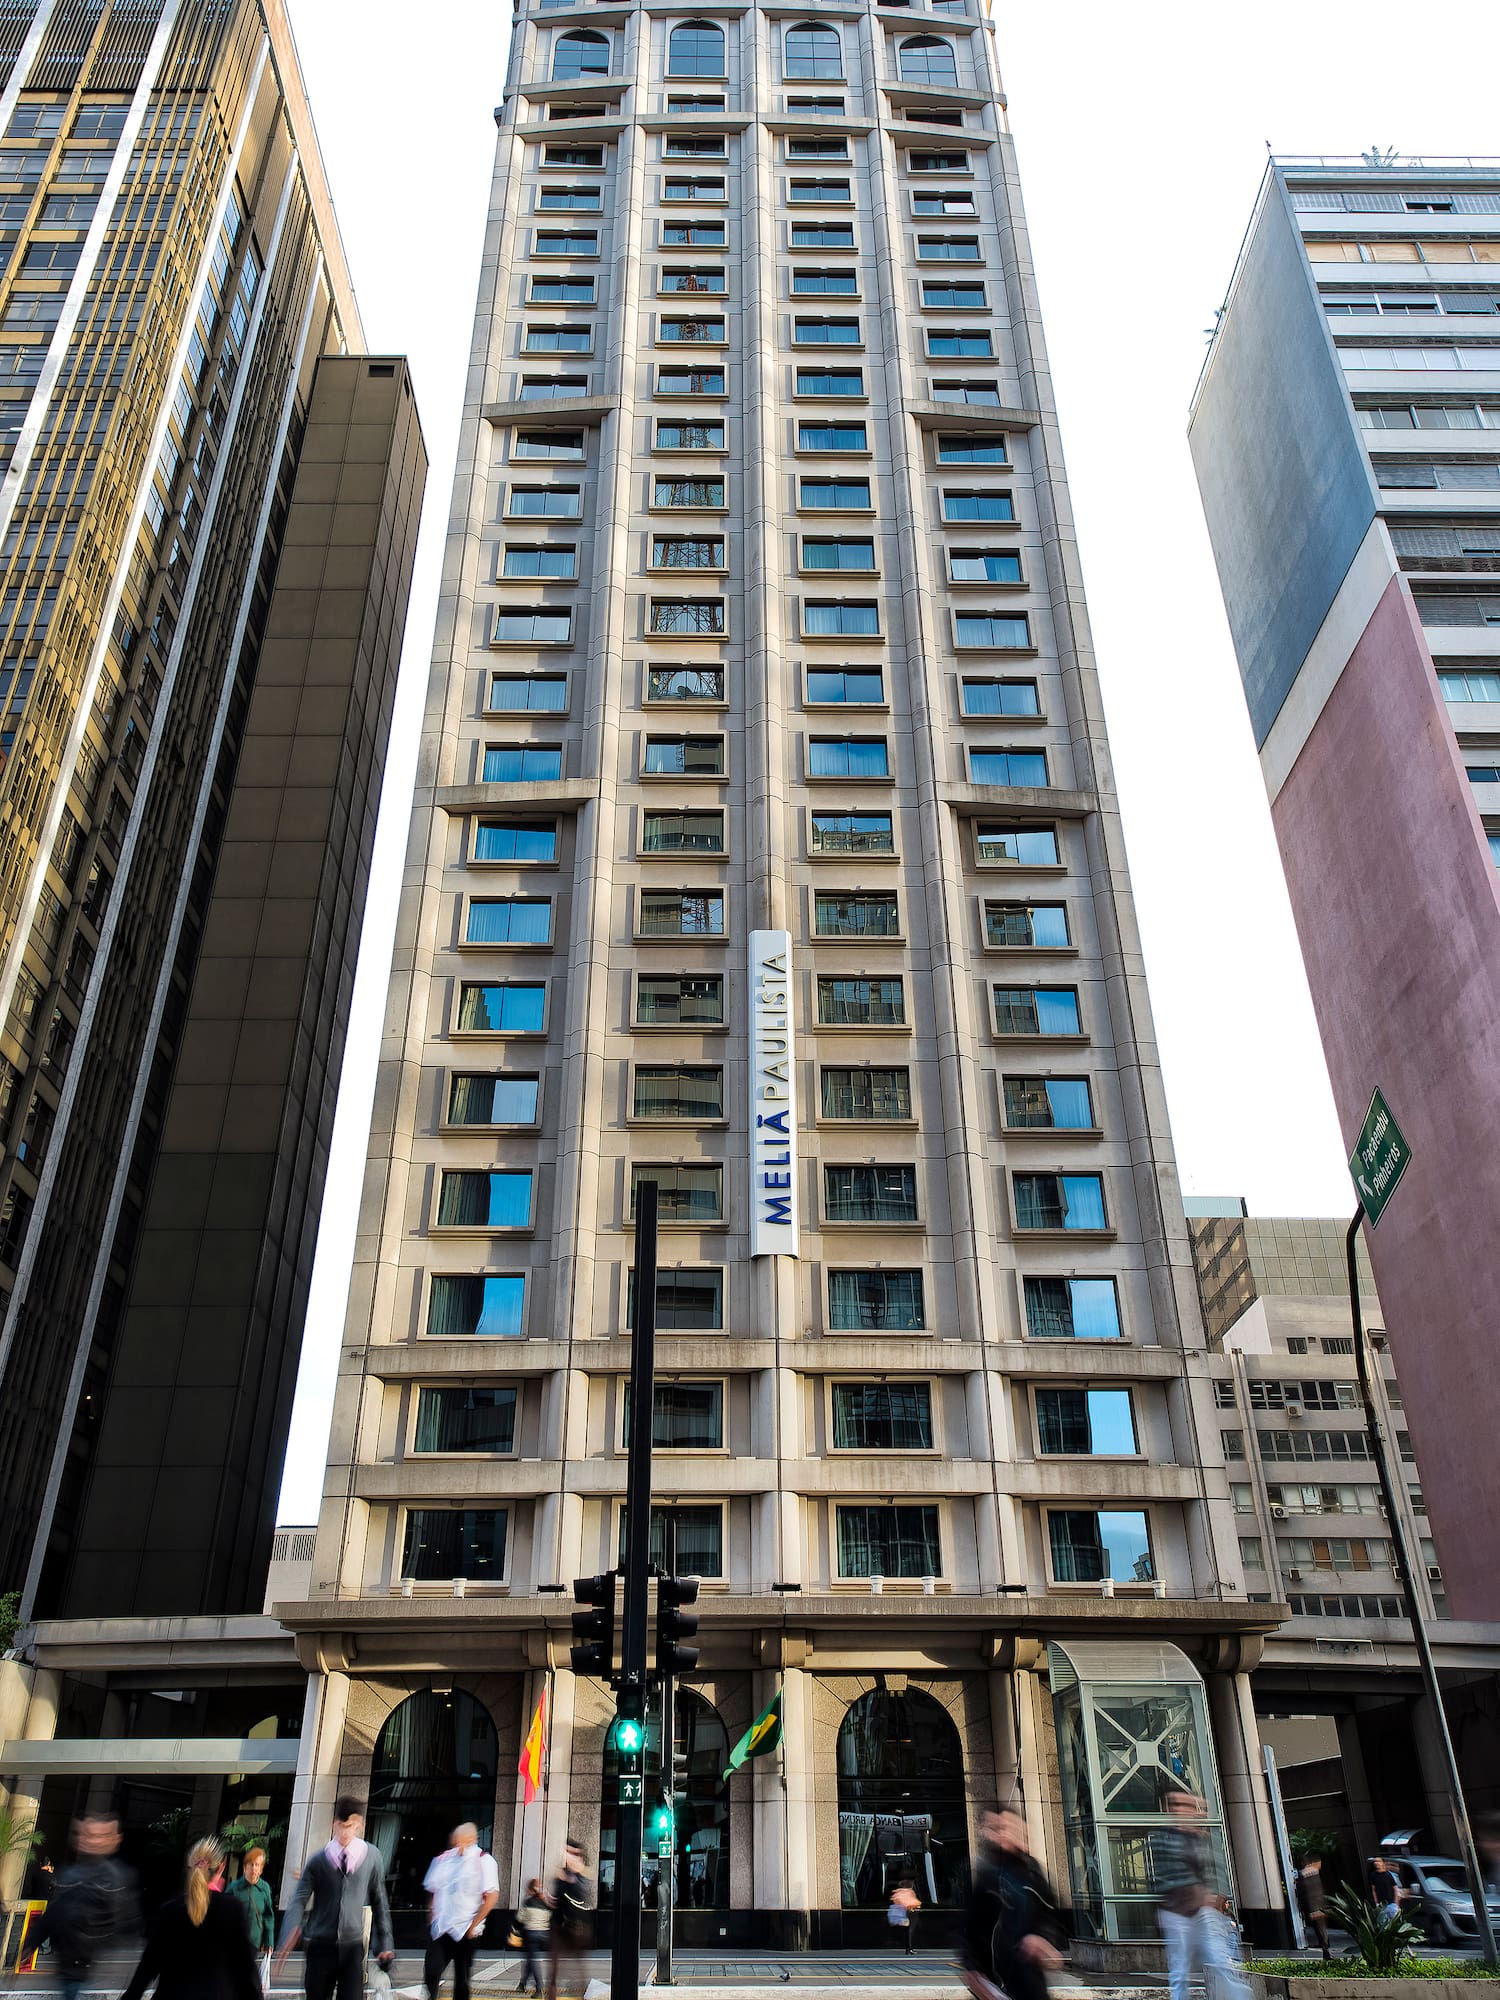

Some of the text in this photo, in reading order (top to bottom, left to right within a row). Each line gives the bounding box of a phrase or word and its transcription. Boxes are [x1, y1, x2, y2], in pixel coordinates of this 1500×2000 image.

[762, 951, 790, 1101] PAULISTA
[1362, 1109, 1389, 1170] Pacaembu
[1372, 1142, 1401, 1197] Pinheiros
